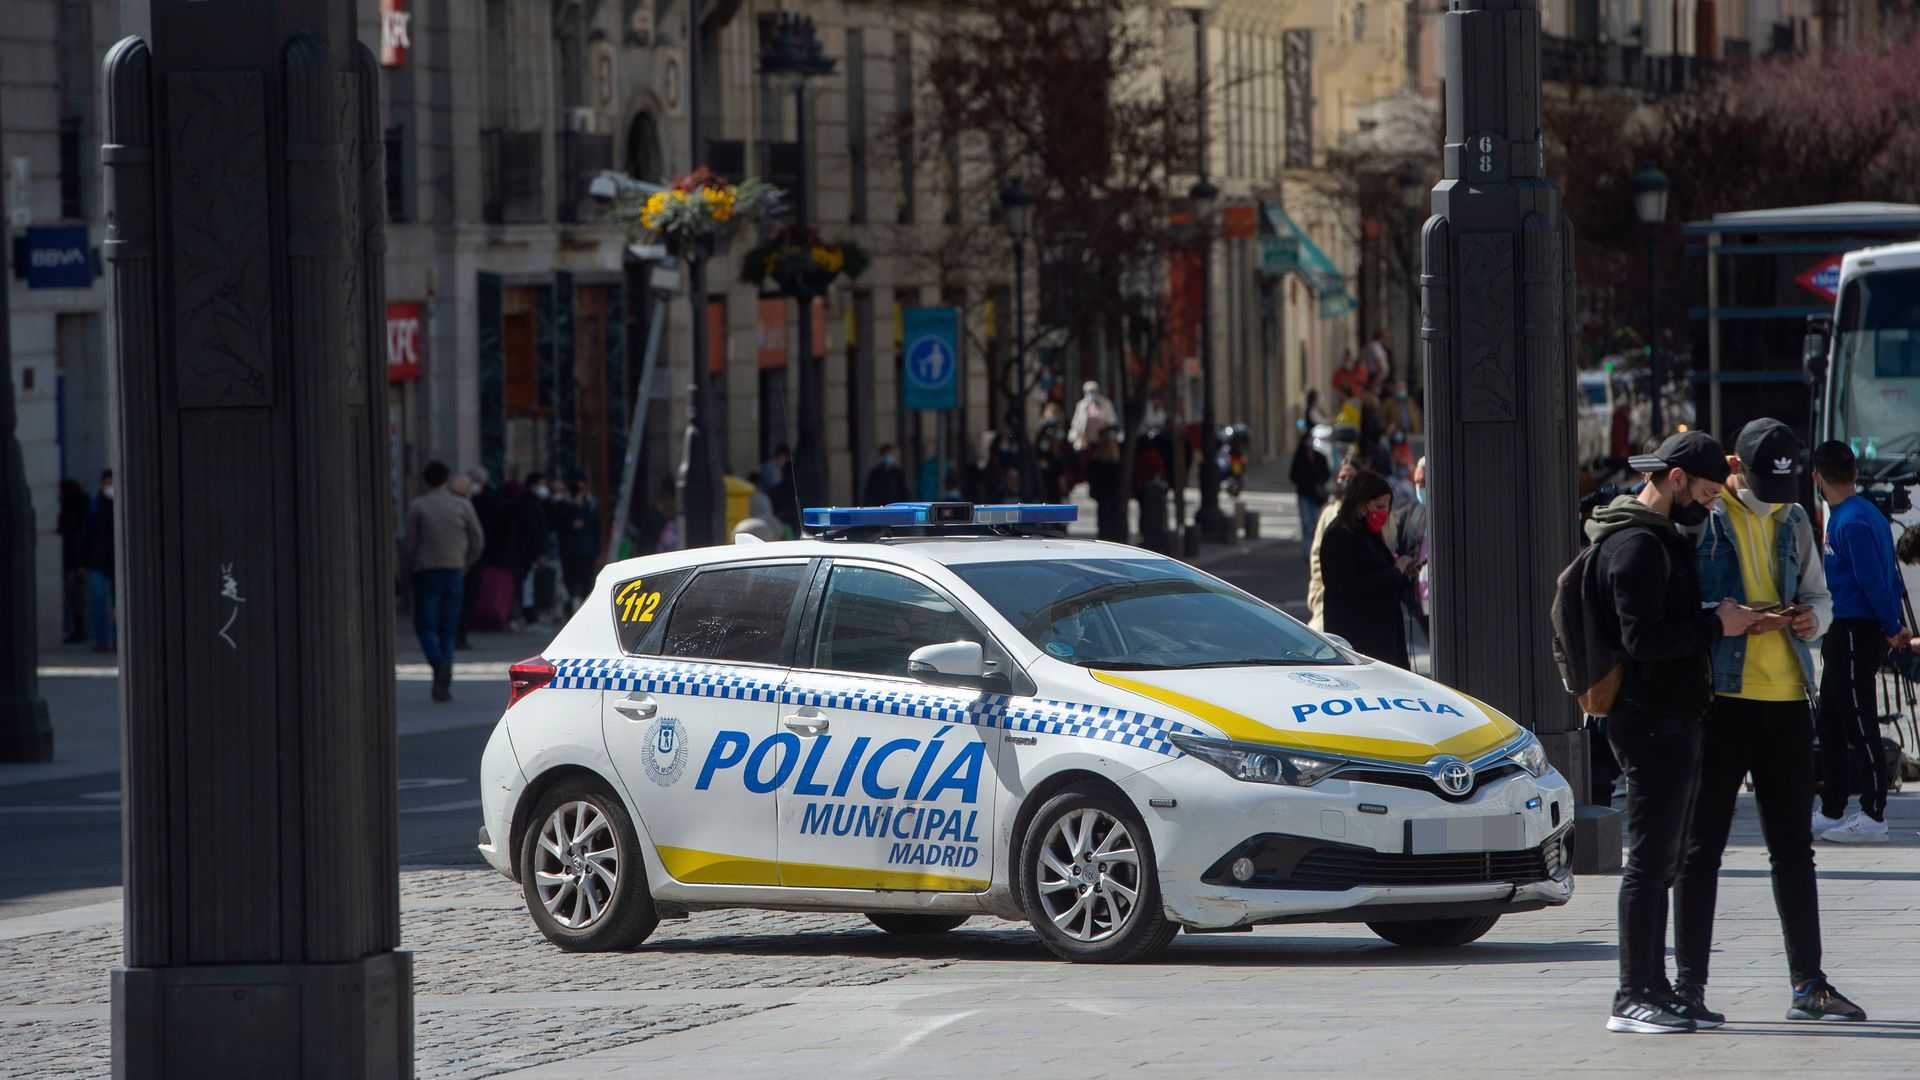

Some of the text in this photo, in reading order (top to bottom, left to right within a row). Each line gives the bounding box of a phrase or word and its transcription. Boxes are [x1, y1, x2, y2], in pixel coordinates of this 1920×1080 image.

[31, 248, 85, 267] BBVA
[621, 591, 660, 622] 112
[1292, 697, 1465, 723] POLICÍA
[661, 748, 679, 773] MUNICIPAL
[695, 725, 987, 804] POLICÍA
[800, 803, 979, 843] MUNICIPAL
[888, 842, 979, 868] MADRID
